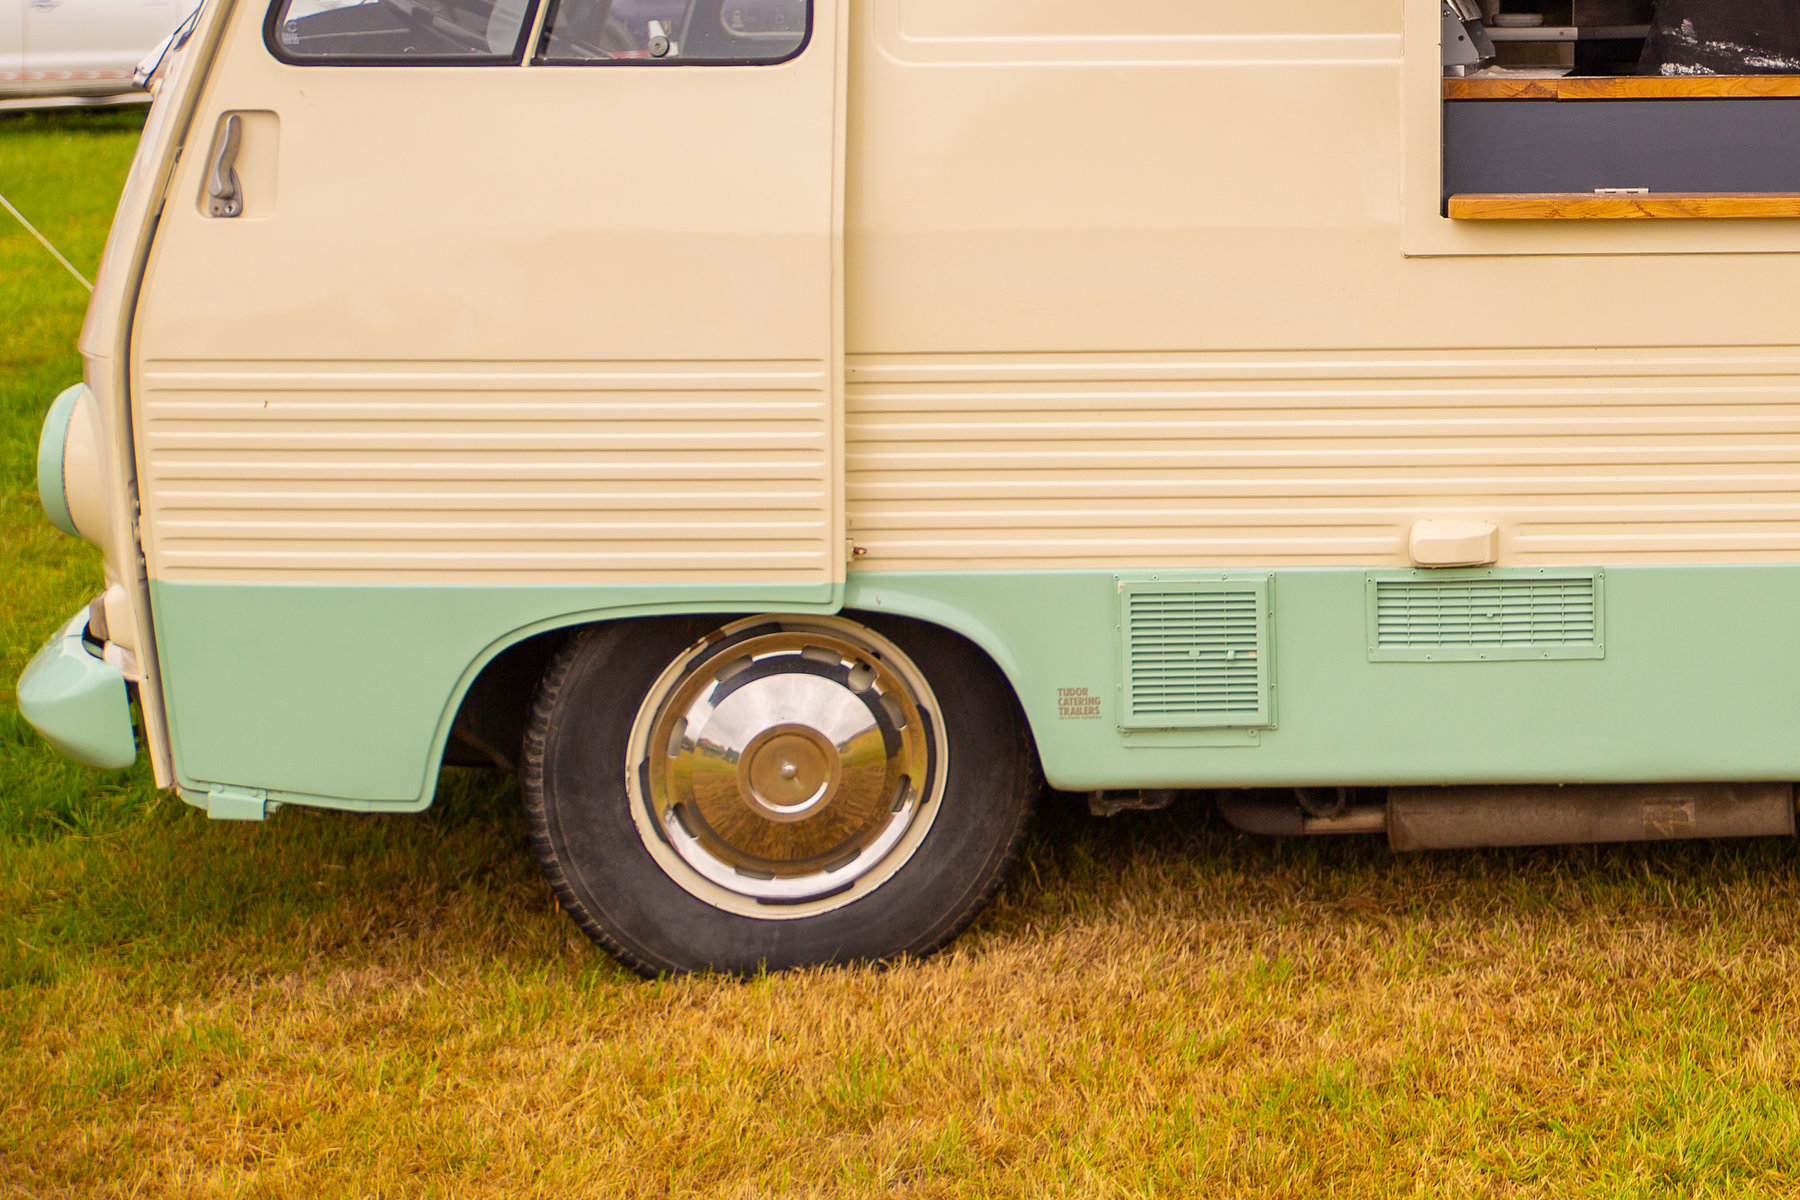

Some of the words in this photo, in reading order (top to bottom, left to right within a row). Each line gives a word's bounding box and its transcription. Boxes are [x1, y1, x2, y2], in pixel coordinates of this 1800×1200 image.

[1057, 687, 1089, 697] TUDOR
[1057, 696, 1101, 706] CATERING
[1058, 706, 1100, 716] TRAILERS
